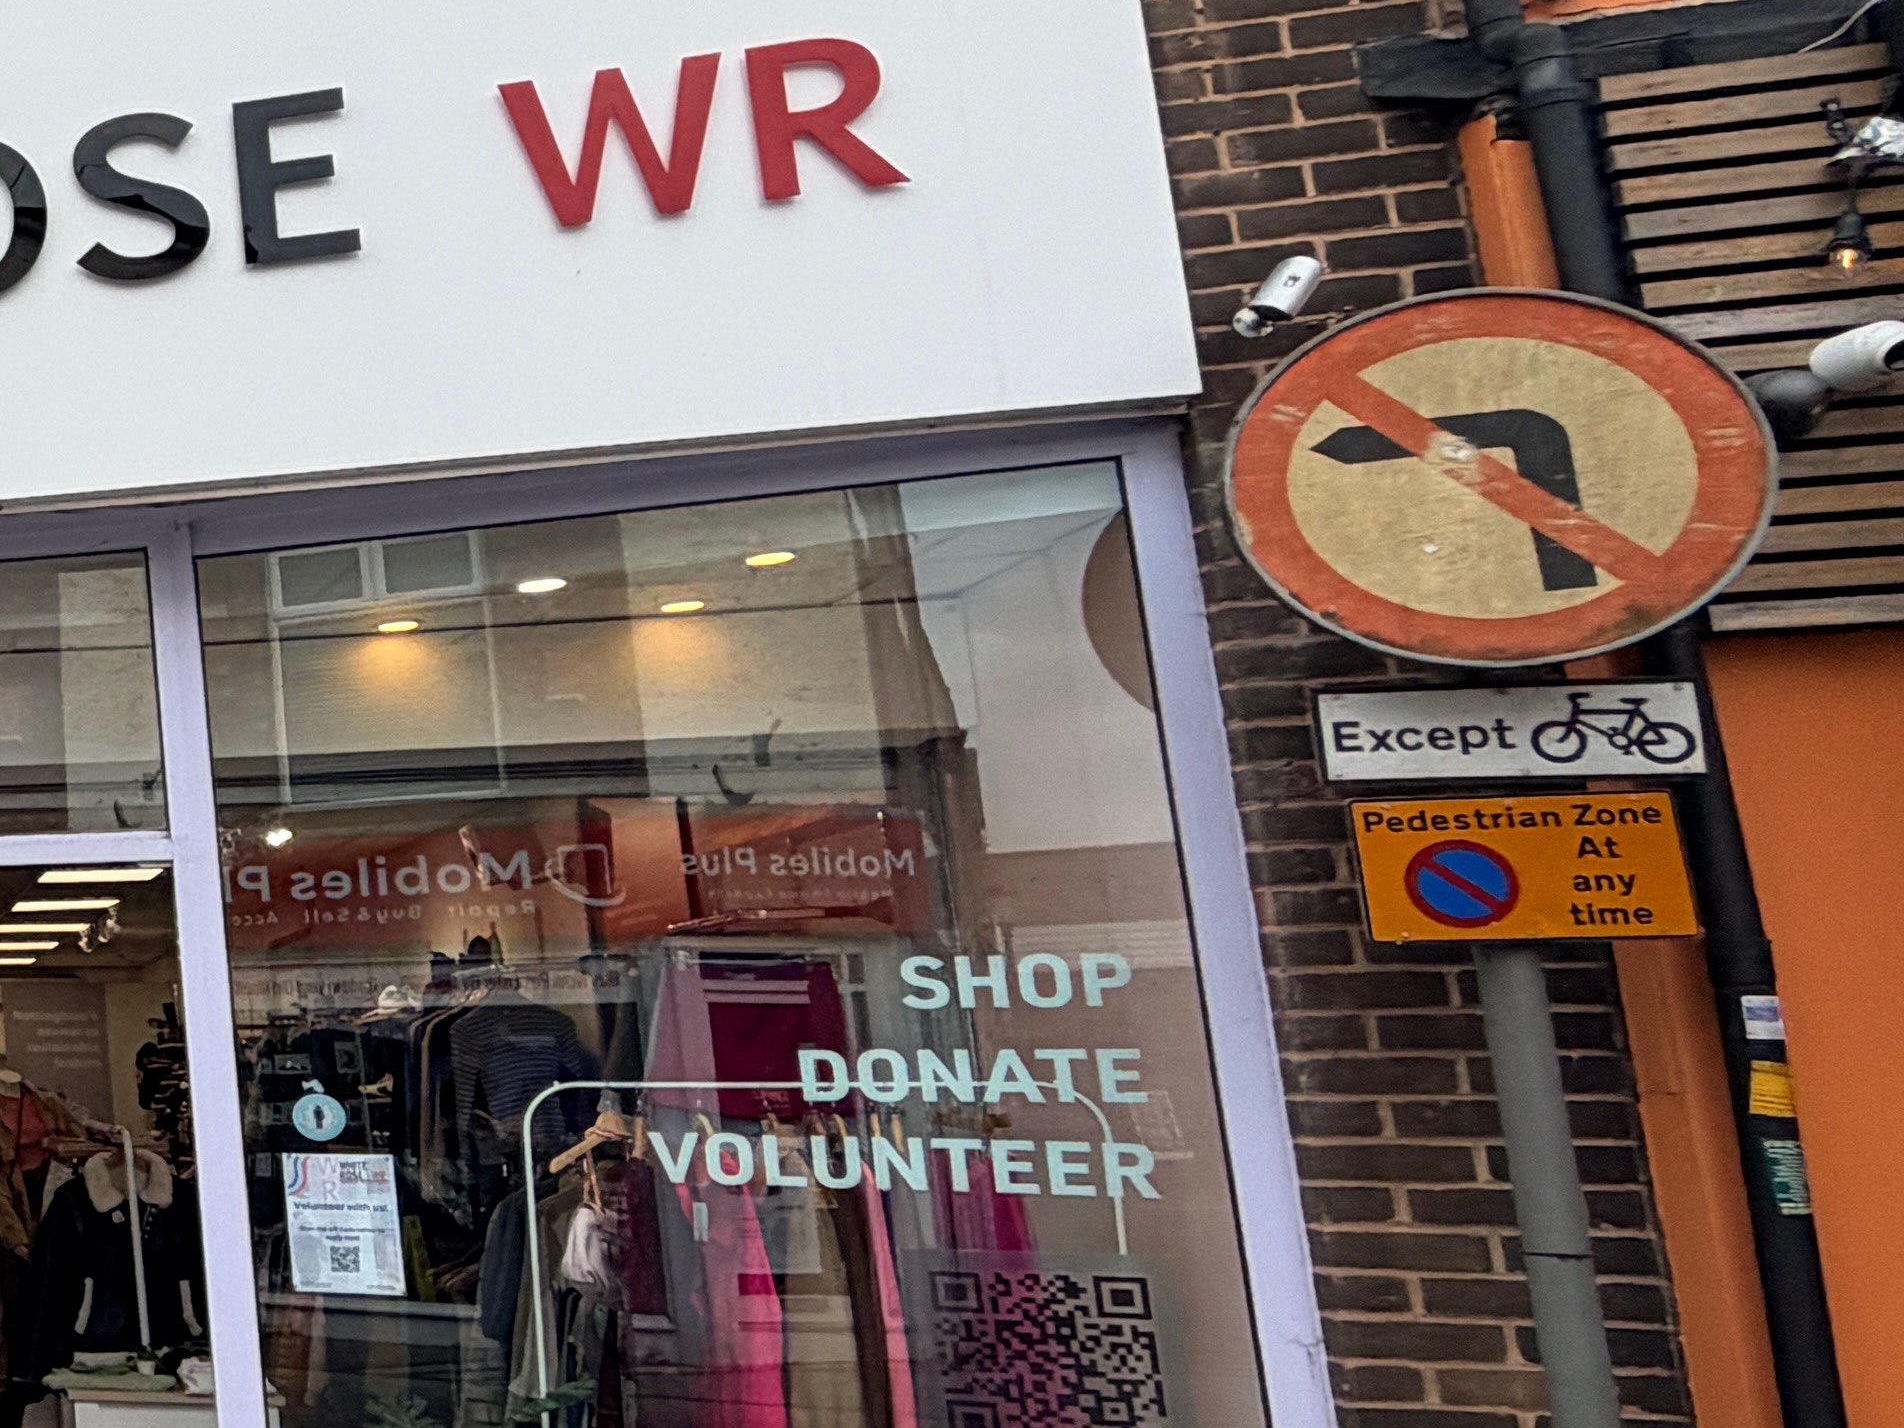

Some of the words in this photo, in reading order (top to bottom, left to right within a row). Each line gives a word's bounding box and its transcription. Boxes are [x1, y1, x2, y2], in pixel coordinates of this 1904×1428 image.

[498, 37, 912, 229] WR
[1332, 716, 1517, 753] Except
[1362, 804, 1562, 833] Pedestrian
[1570, 802, 1663, 826] Zone
[1577, 834, 1622, 859] At
[1572, 871, 1636, 898] any
[1568, 901, 1655, 926] time
[898, 952, 1132, 1011] SHOP
[798, 1045, 1150, 1105] DONATE
[649, 1130, 1163, 1201] VOLUNTEER
